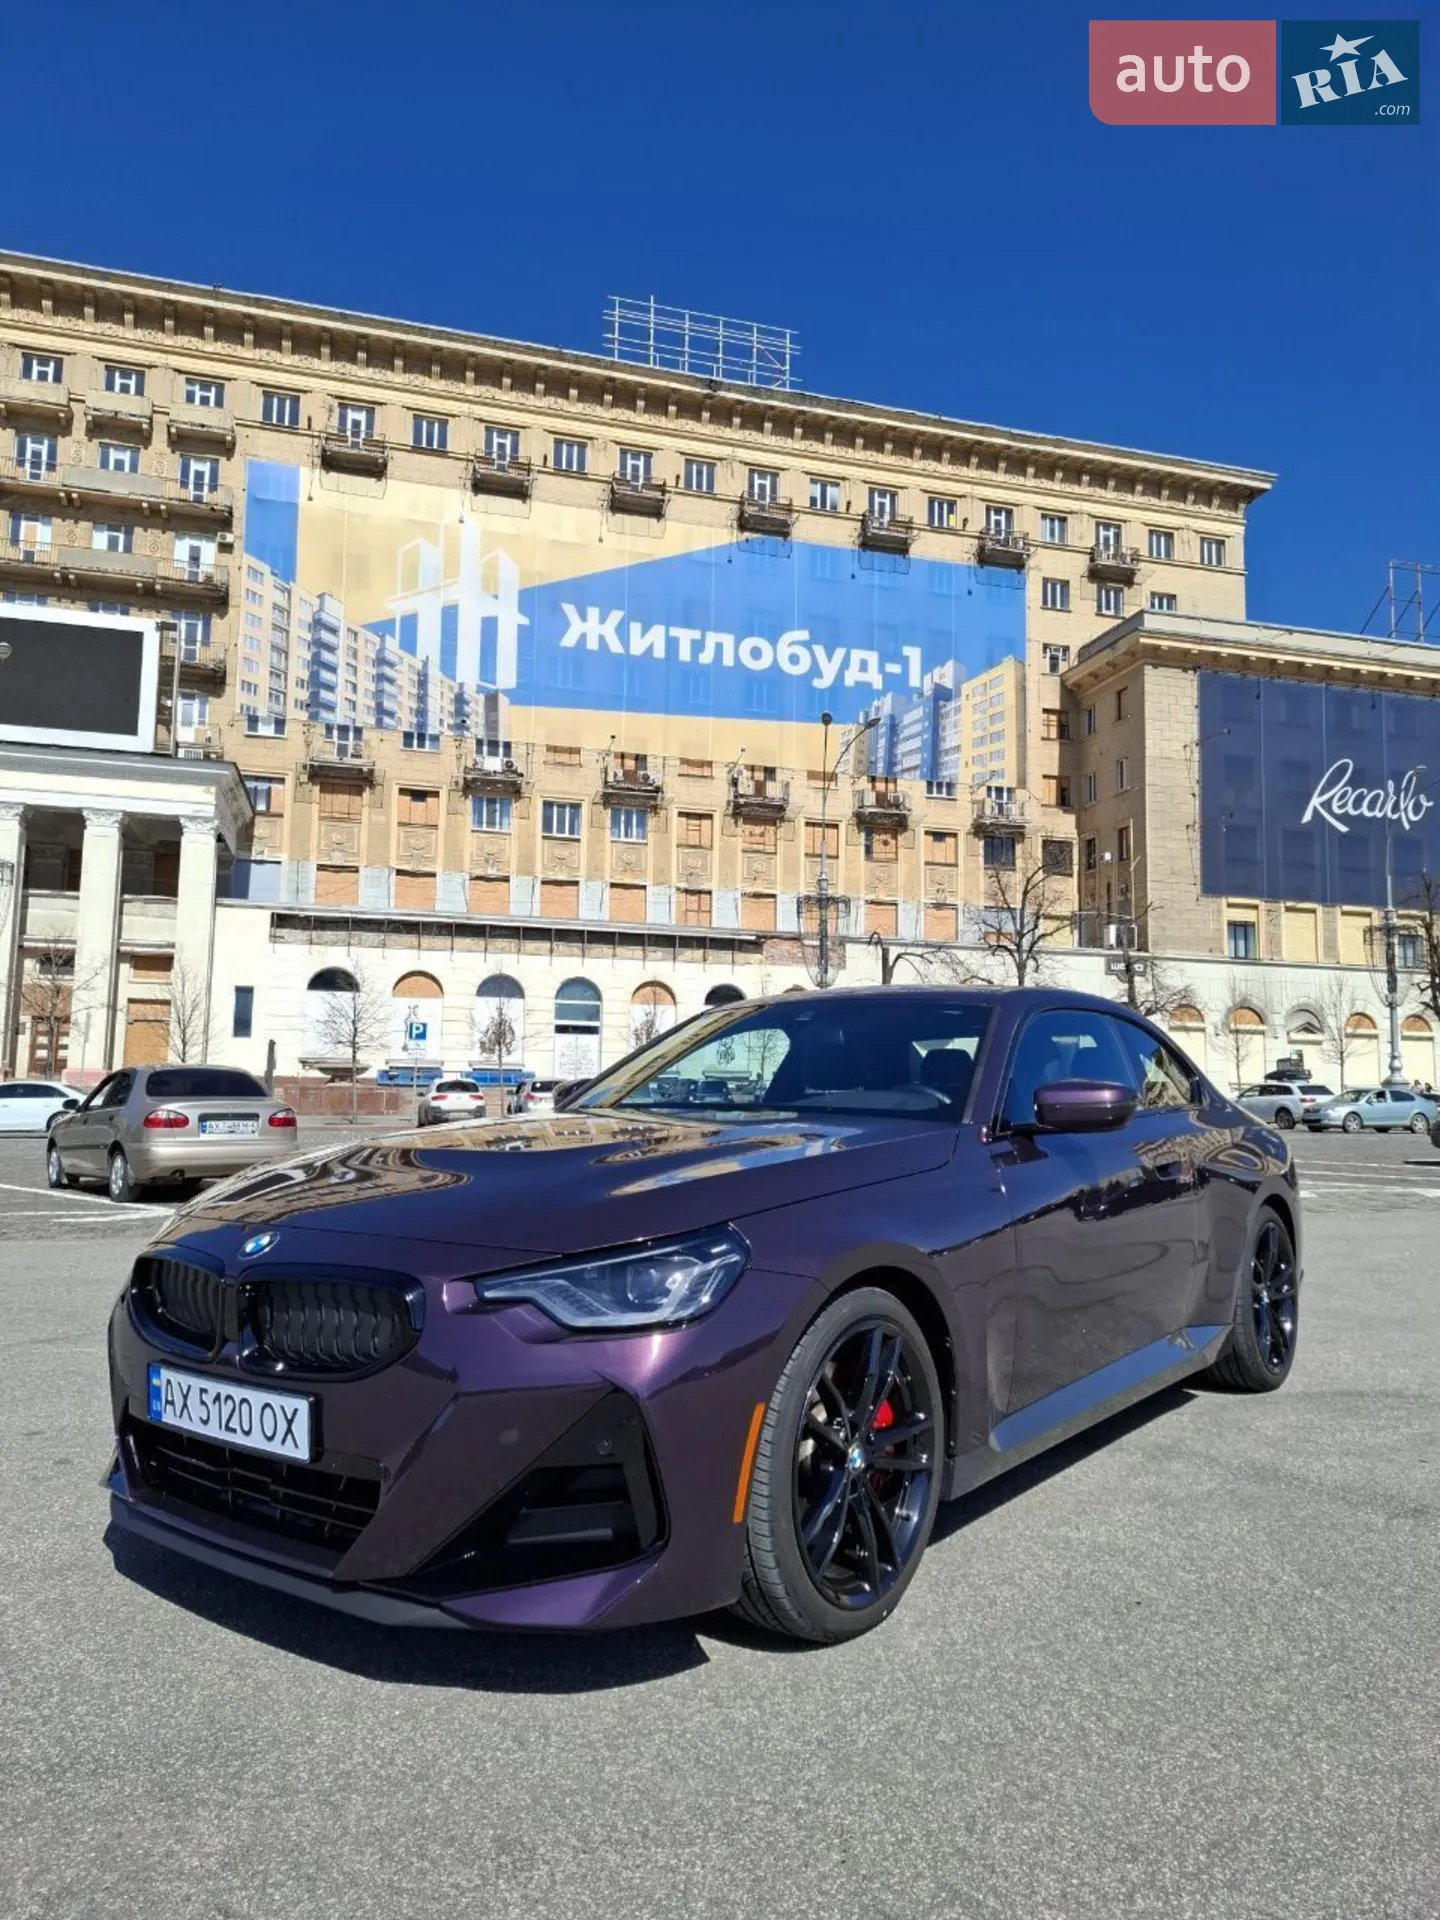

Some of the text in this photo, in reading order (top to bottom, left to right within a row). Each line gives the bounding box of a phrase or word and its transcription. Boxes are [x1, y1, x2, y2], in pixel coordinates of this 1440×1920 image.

[559, 602, 922, 690] Житлобуд-1
[1301, 758, 1434, 833] Recarlo
[412, 1023, 424, 1040] P
[163, 1378, 299, 1450] AX 5120 OX
